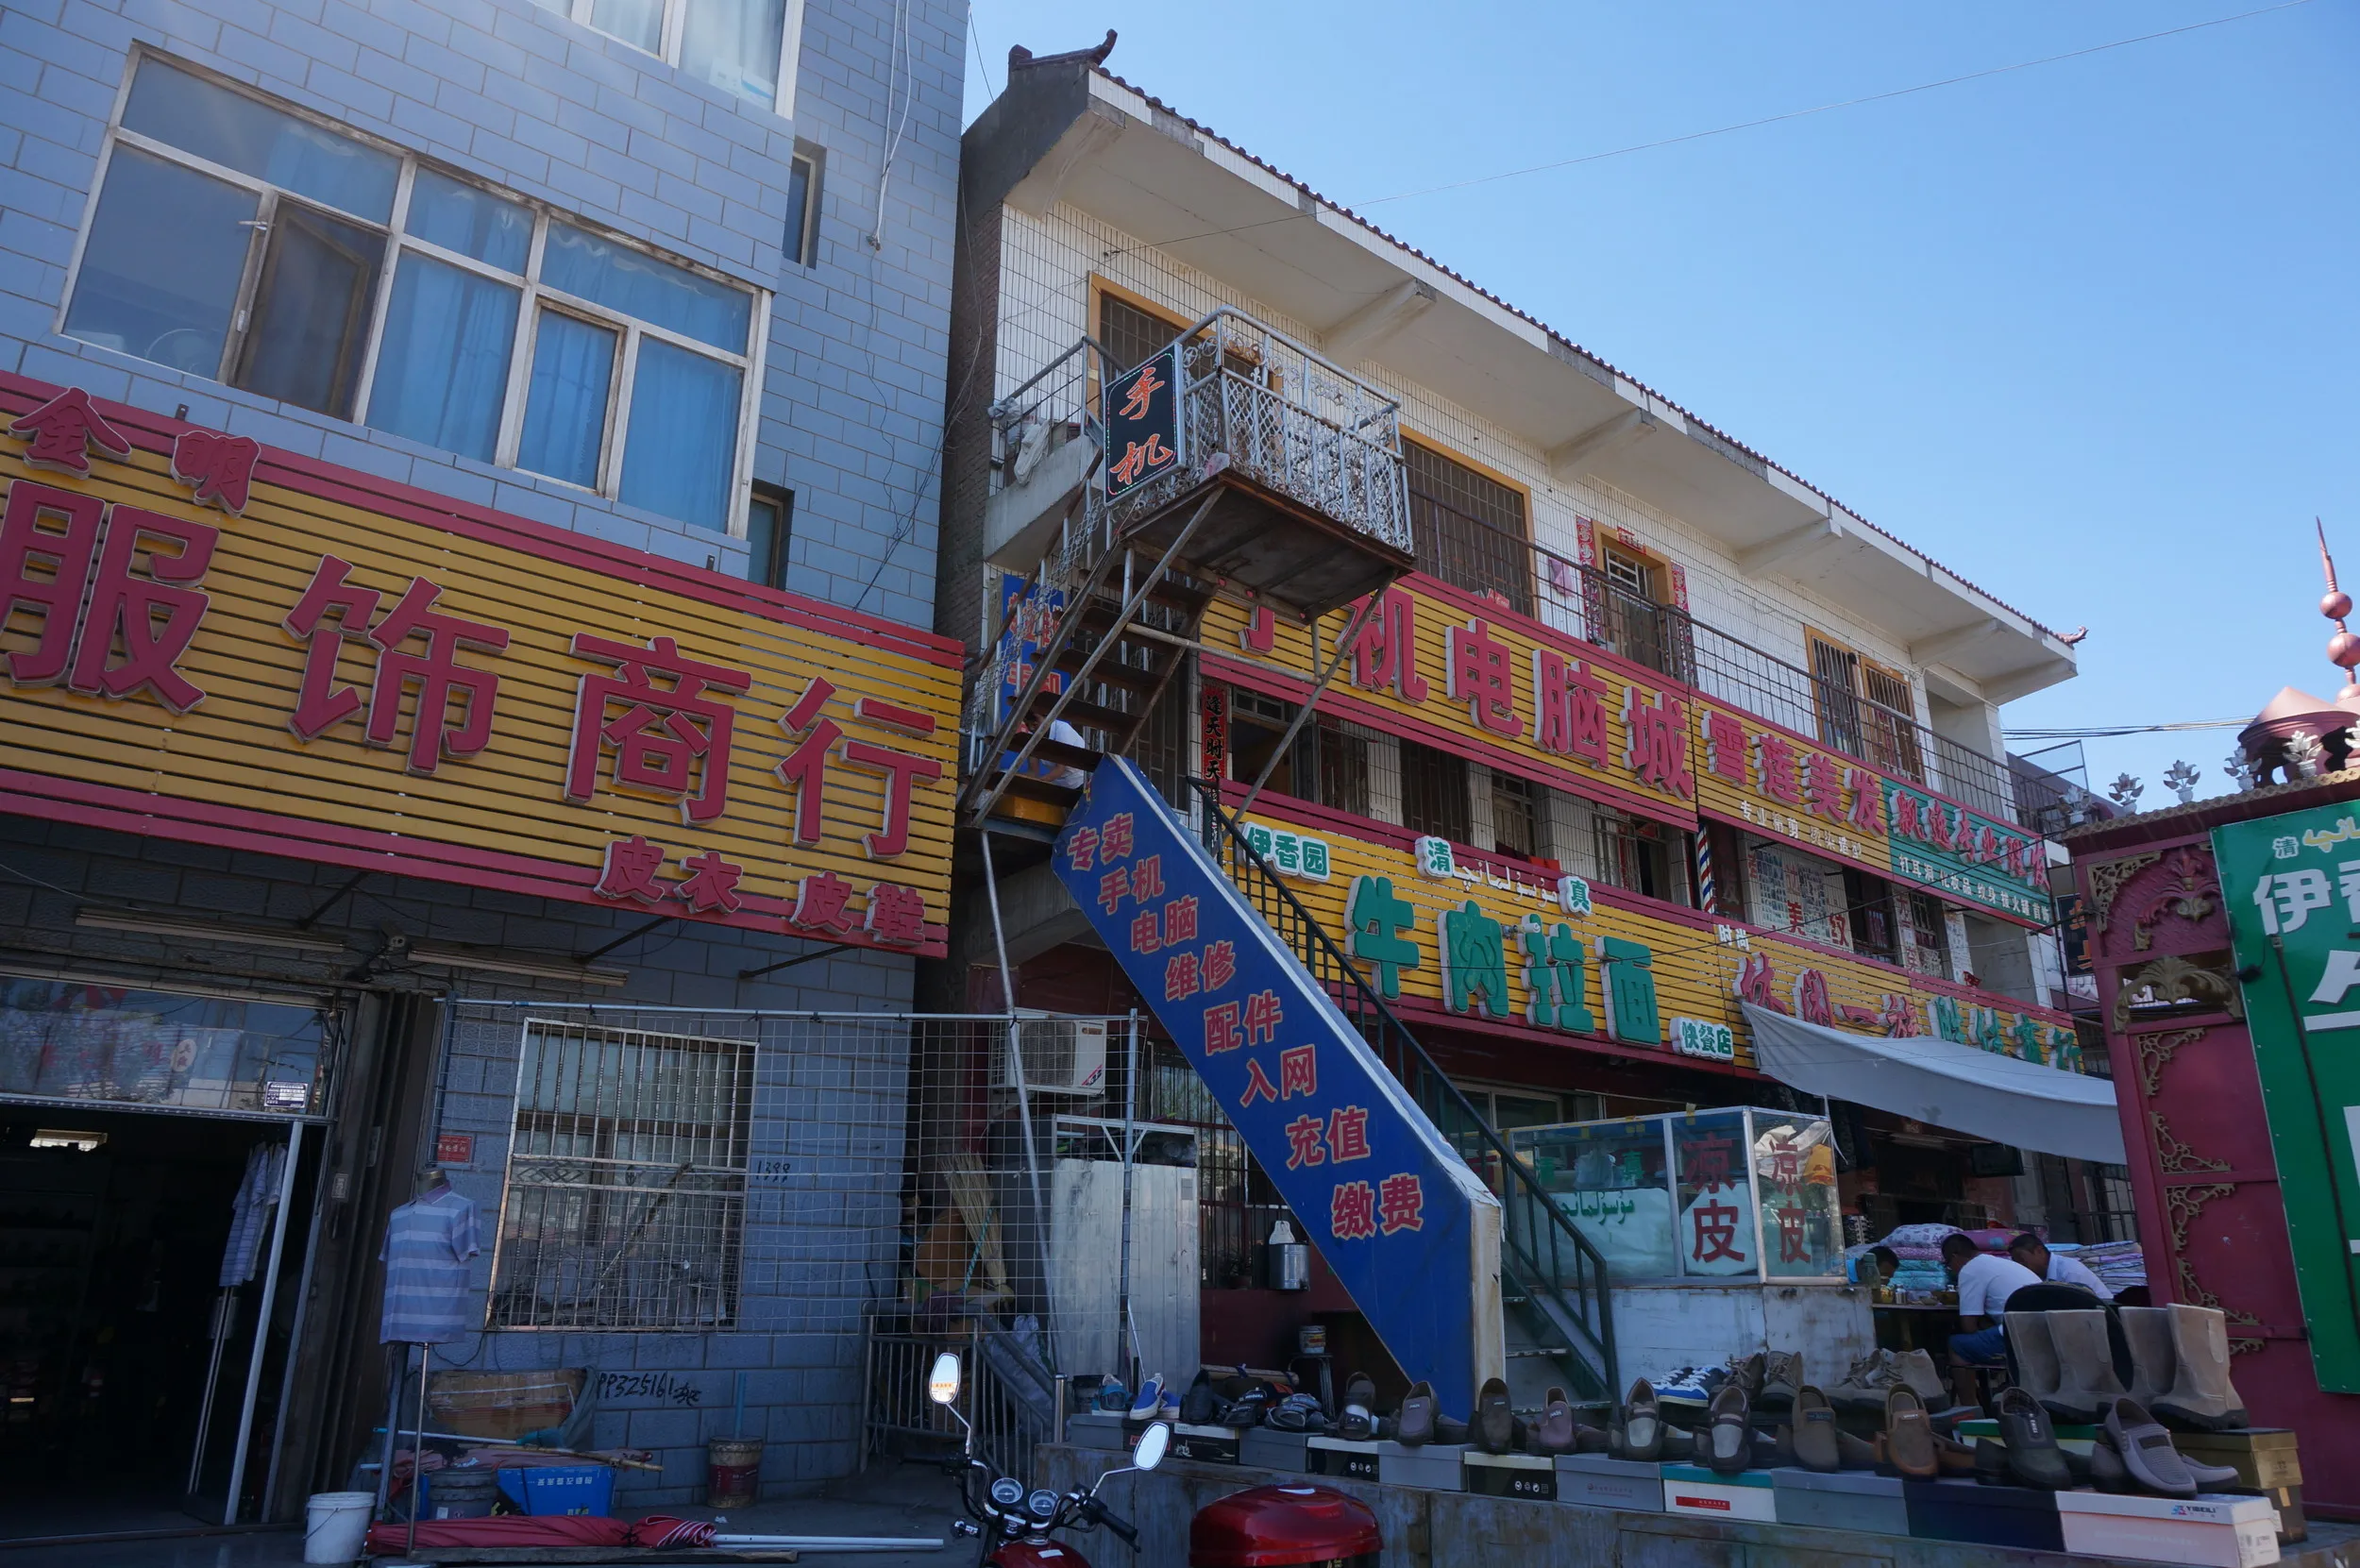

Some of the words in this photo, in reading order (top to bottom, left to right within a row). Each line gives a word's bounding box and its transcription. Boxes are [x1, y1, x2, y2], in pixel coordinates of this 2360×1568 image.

[1109, 366, 1173, 485] 手机
[0, 479, 942, 861] 服饰商行
[1239, 585, 1694, 801] 机电脑城
[1702, 709, 1886, 838] 雪莲美发
[1068, 813, 1134, 872] 专卖
[1244, 824, 1330, 878] 伊香园
[1427, 838, 1453, 874] 清
[2272, 835, 2300, 859] 清
[594, 835, 744, 917] 皮衣
[789, 869, 926, 945] 皮鞋
[1098, 854, 1166, 916] 手机
[1570, 878, 1592, 914] 真
[1898, 853, 1935, 883] 打耳洞
[1939, 868, 1973, 896] 化妆品
[1130, 896, 1199, 954] 电脑
[1718, 923, 1750, 952] 时尚
[1165, 940, 1237, 1003] 维修
[1345, 874, 1662, 1046] 牛肉拉面
[1204, 989, 1284, 1056] 配件
[1679, 1021, 1733, 1059] 快餐店
[1239, 1044, 1317, 1108] 入网
[1286, 1105, 1372, 1171] 充值
[1331, 1172, 1424, 1240] 缴费
[1683, 1132, 1746, 1265] 凉皮
